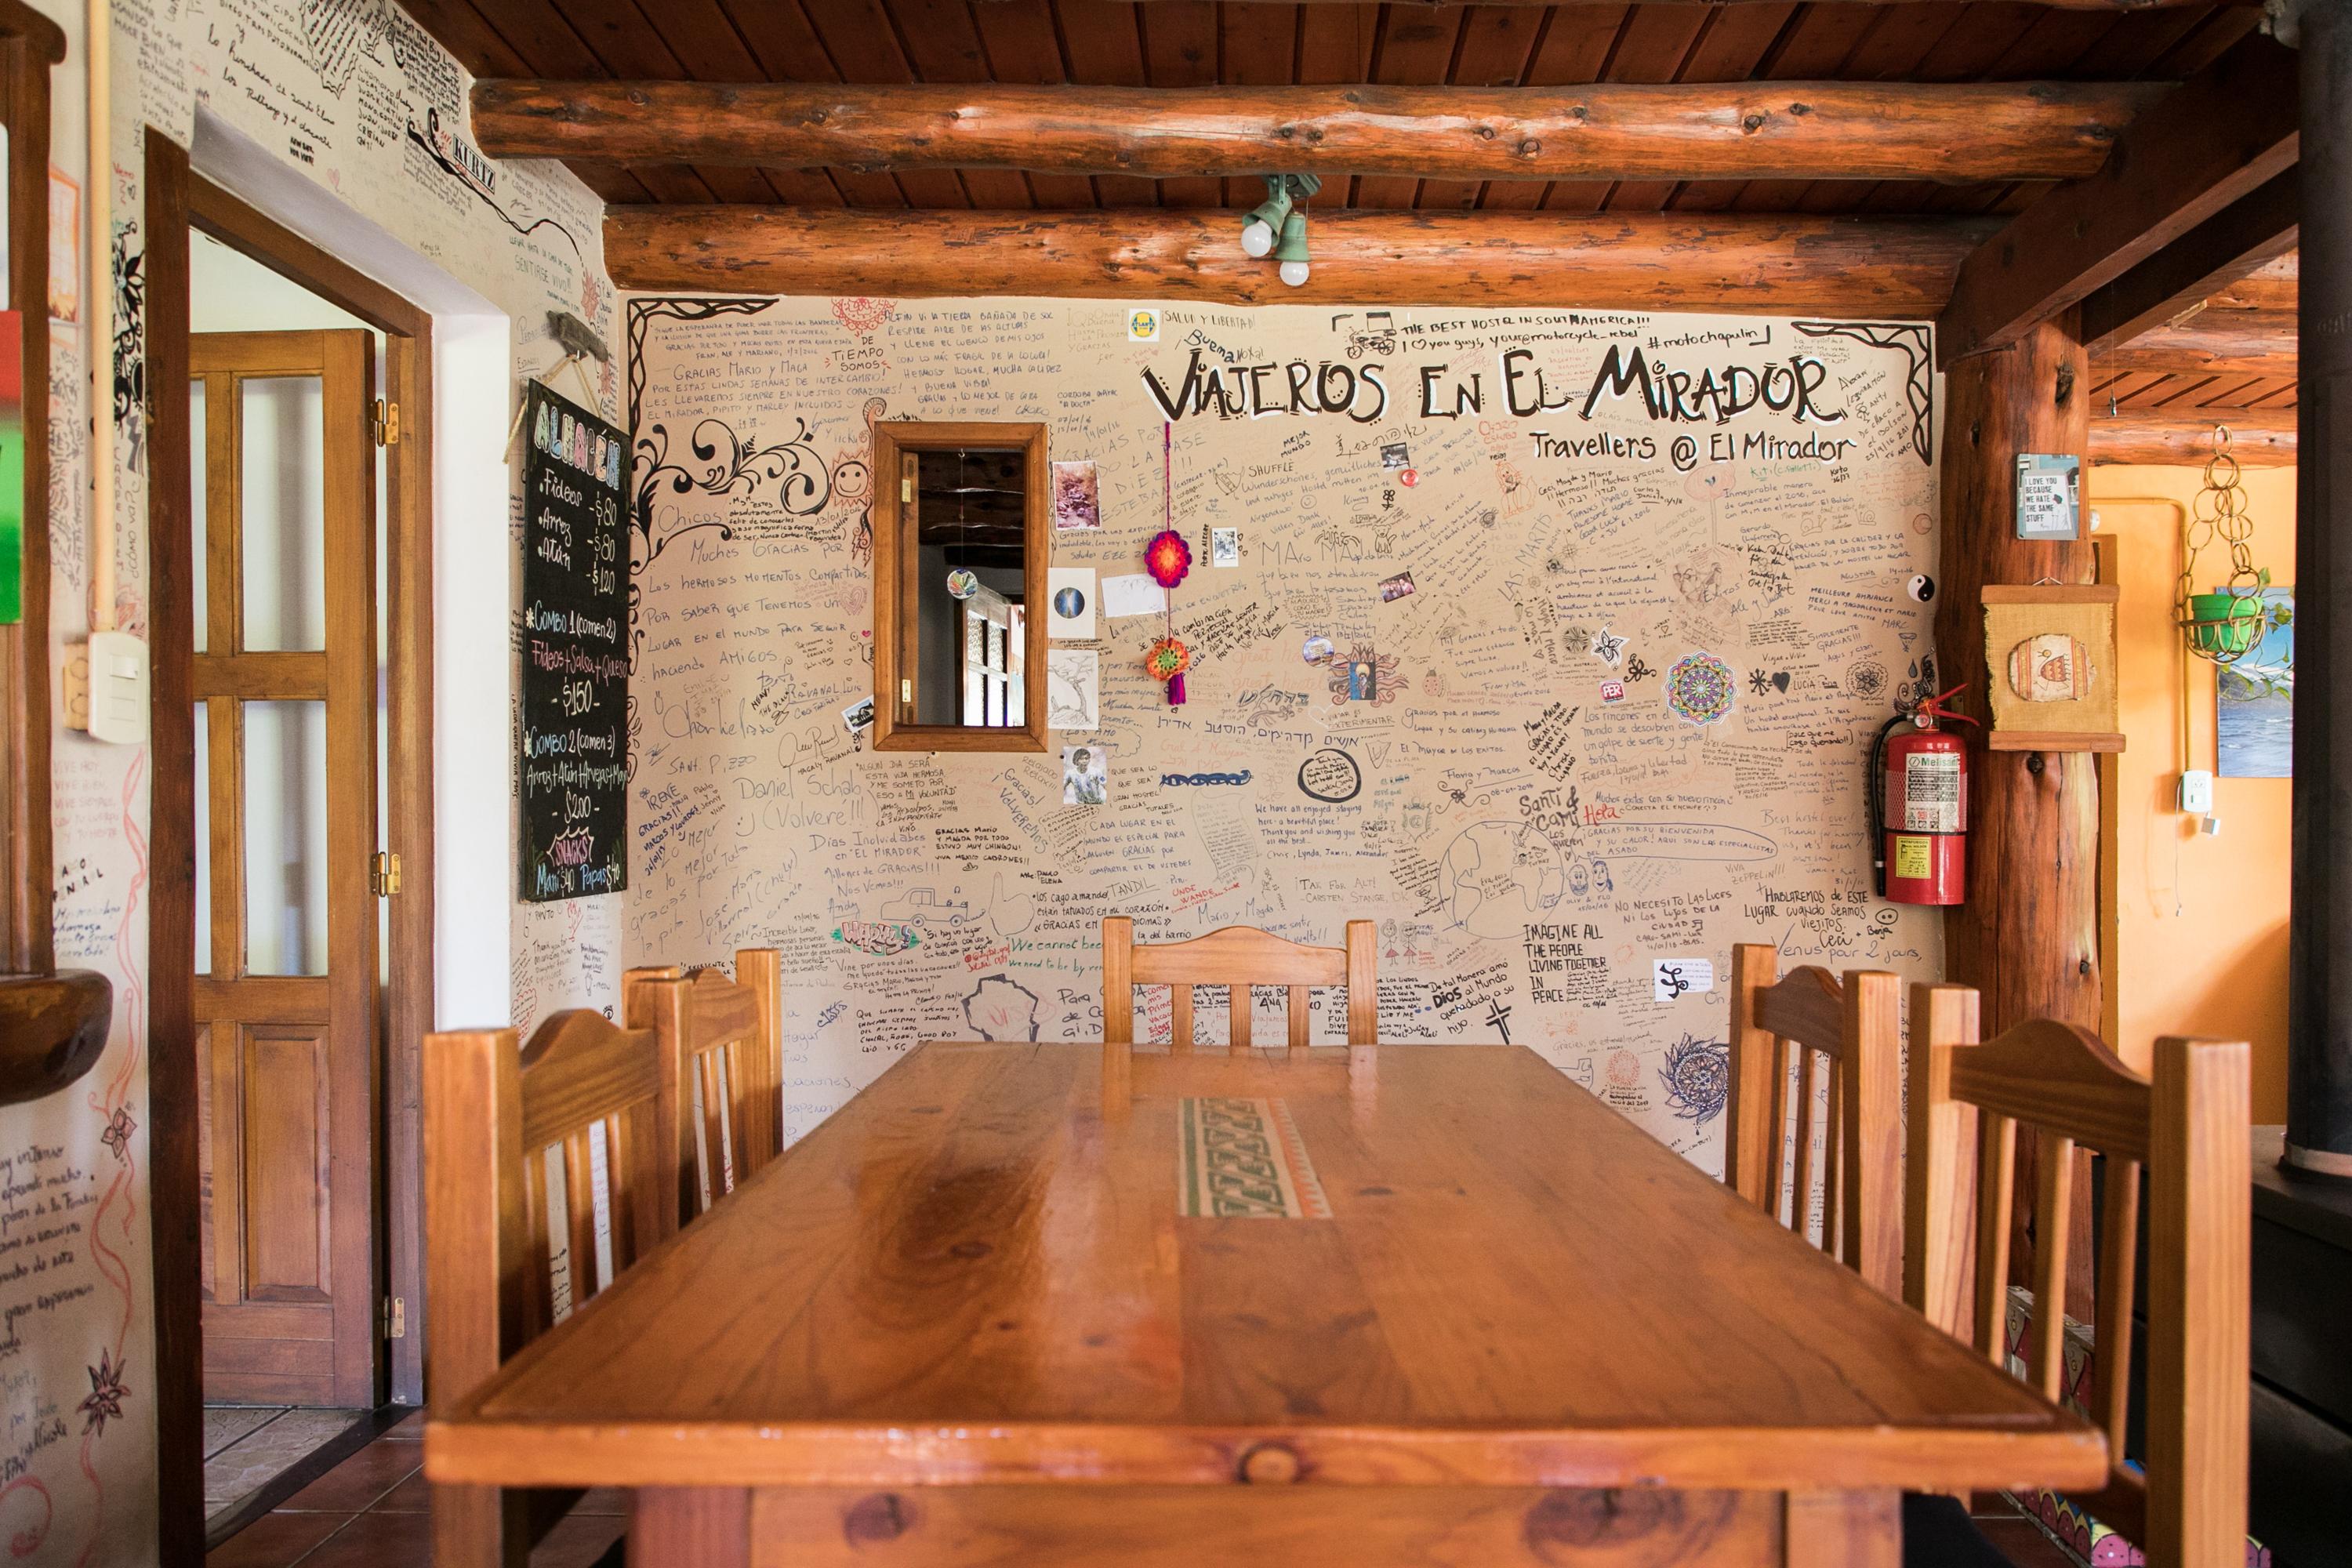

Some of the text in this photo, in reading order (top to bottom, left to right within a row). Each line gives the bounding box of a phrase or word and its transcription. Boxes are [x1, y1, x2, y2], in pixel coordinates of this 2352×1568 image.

[455, 137, 494, 191] KURTZ
[1401, 324, 1425, 335] THE
[1430, 321, 1465, 332] BEST
[862, 336, 873, 345] DE
[1429, 341, 1450, 350] you
[673, 364, 721, 381] GRACIAS
[840, 360, 880, 372] SOMOS
[1418, 365, 1484, 419] EN
[1501, 347, 1574, 419] EL
[1530, 431, 1855, 470] Travellers @ El Mirador
[544, 468, 582, 507] Fideos
[543, 506, 572, 547] Arroz
[659, 506, 722, 532] Chicos
[543, 537, 571, 572] Atún
[569, 610, 575, 633] 1
[562, 676, 592, 717] $150
[1603, 684, 1621, 697] PER
[1584, 707, 1599, 723] Los
[1602, 712, 1640, 721] rincones
[568, 729, 575, 753] 2
[733, 767, 793, 800] Daniel
[564, 786, 591, 823] $200
[1255, 804, 1267, 814] We
[1304, 804, 1331, 817] enjoyed
[1336, 804, 1362, 817] staying
[1120, 819, 1146, 828] LUGAR
[555, 836, 588, 866] SNACKS
[580, 863, 606, 891] Papas
[1105, 877, 1156, 898] TANDIL
[1764, 889, 1869, 903] HABLAREMOS de ESTE
[1615, 901, 1631, 913] NO
[1744, 905, 1780, 924] LUGAR
[1523, 924, 1604, 942] IMAGINE ALL
[1819, 929, 1853, 949] Ceci
[1523, 943, 1583, 958] THE PEOPLE
[1828, 948, 1858, 964] pour
[1865, 941, 1879, 958] 2
[1529, 956, 1606, 974] LIVING TOGETHER
[1443, 977, 1456, 987] tal
[1457, 970, 1487, 984] Manera
[1465, 985, 1475, 995] al
[1475, 973, 1508, 991] Mundo
[1531, 975, 1543, 989] IN
[1504, 985, 1515, 995] su
[1533, 989, 1563, 1004] PEACE
